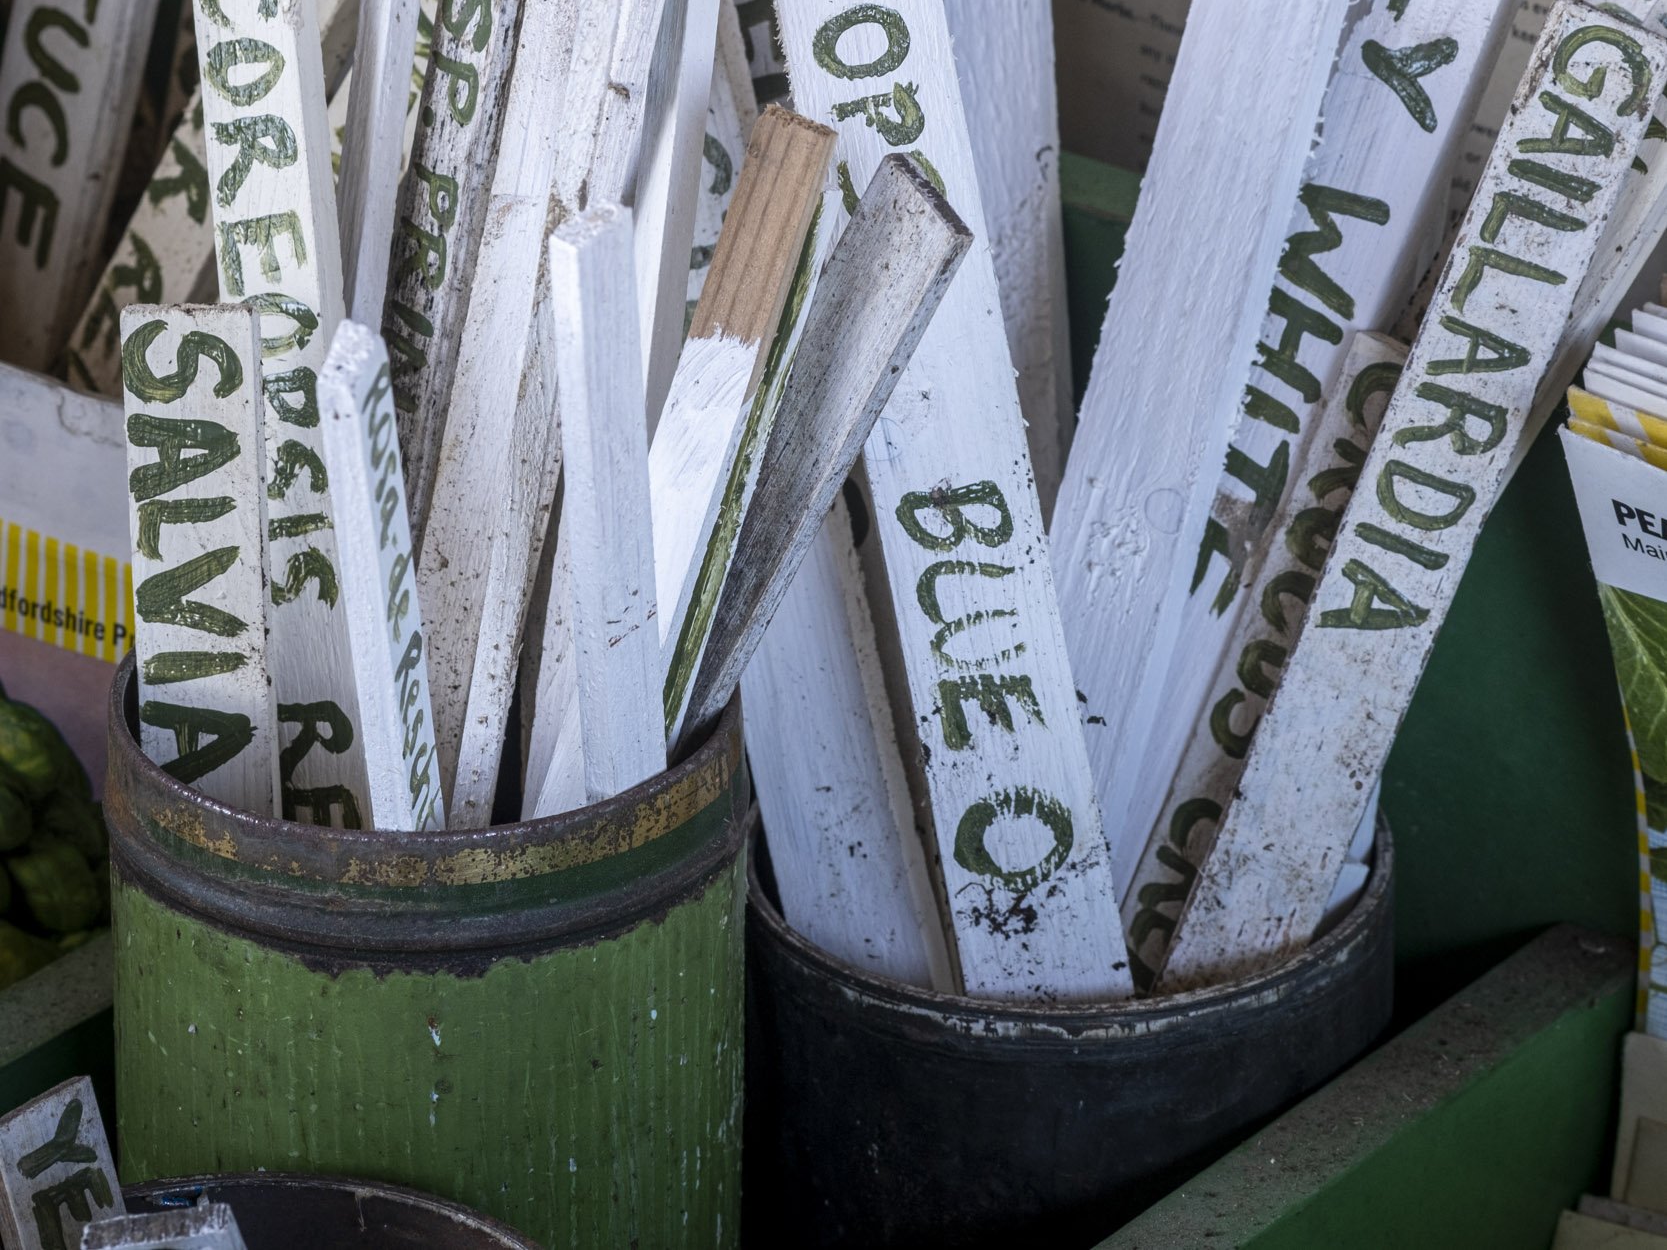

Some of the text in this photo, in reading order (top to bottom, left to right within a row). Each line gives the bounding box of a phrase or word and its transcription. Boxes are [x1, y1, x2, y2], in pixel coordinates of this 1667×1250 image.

[1316, 25, 1651, 630] GAILLARDIA
[122, 319, 258, 784] SALVIA
[896, 479, 1048, 752] BLUE
[1622, 532, 1667, 562] Mai
